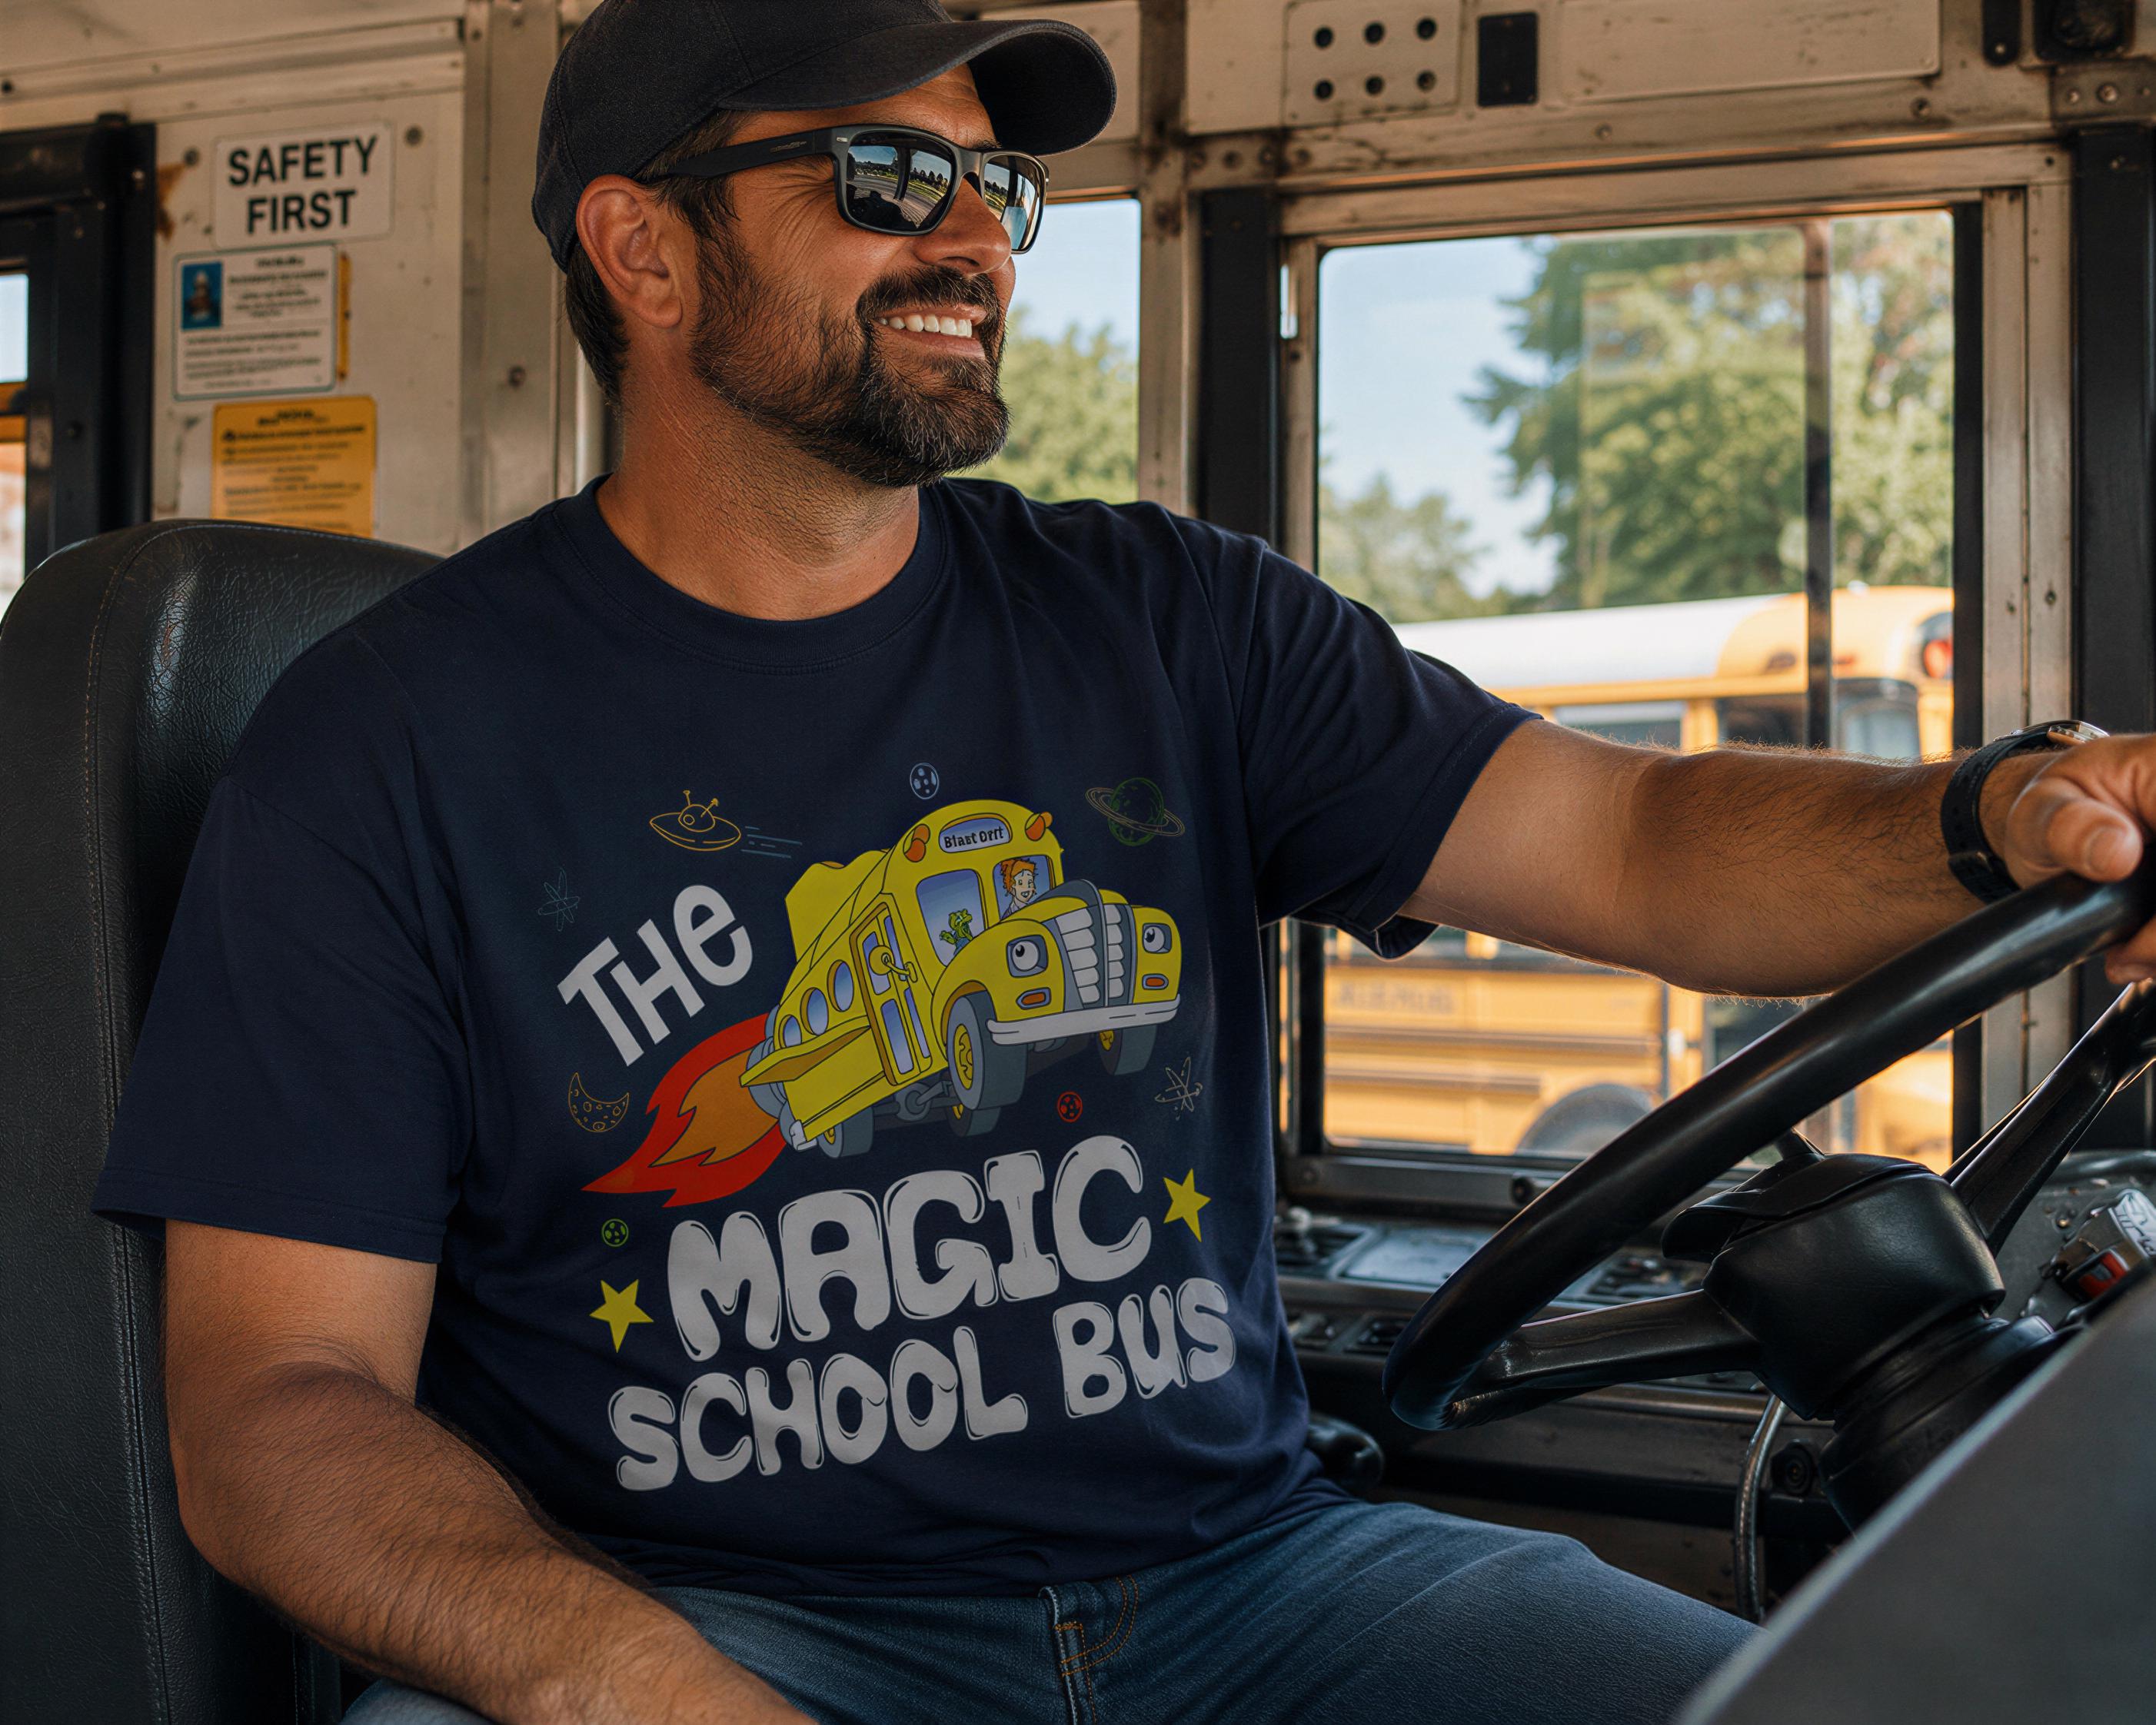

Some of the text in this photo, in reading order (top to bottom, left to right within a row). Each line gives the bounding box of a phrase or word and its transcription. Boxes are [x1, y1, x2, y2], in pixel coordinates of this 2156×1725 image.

[228, 135, 378, 188] SAFETY
[248, 189, 357, 234] FIRST
[667, 1135, 1152, 1361] MAGIC
[608, 1278, 1236, 1491] SCHOOL BUS
